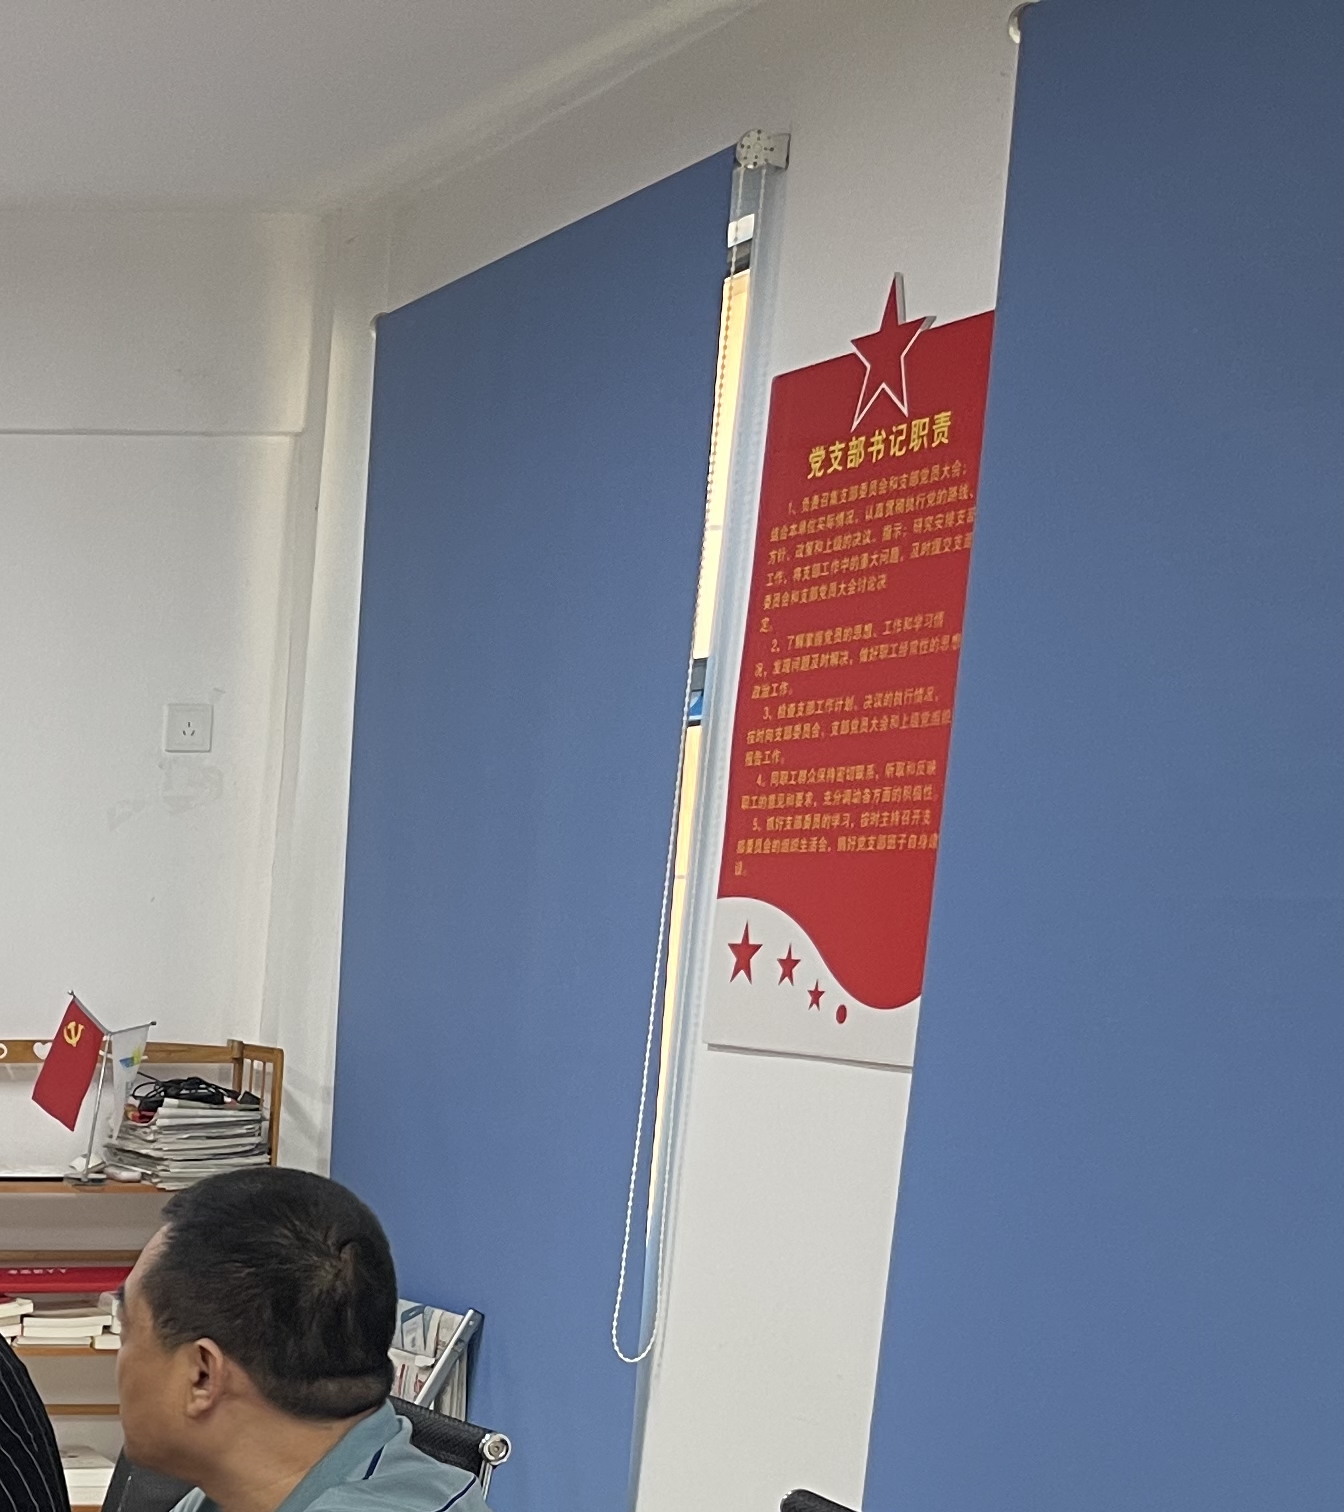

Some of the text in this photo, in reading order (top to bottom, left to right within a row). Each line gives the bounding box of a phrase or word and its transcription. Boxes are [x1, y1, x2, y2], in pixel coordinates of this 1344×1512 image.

[806, 411, 952, 479] 党支部书记职责
